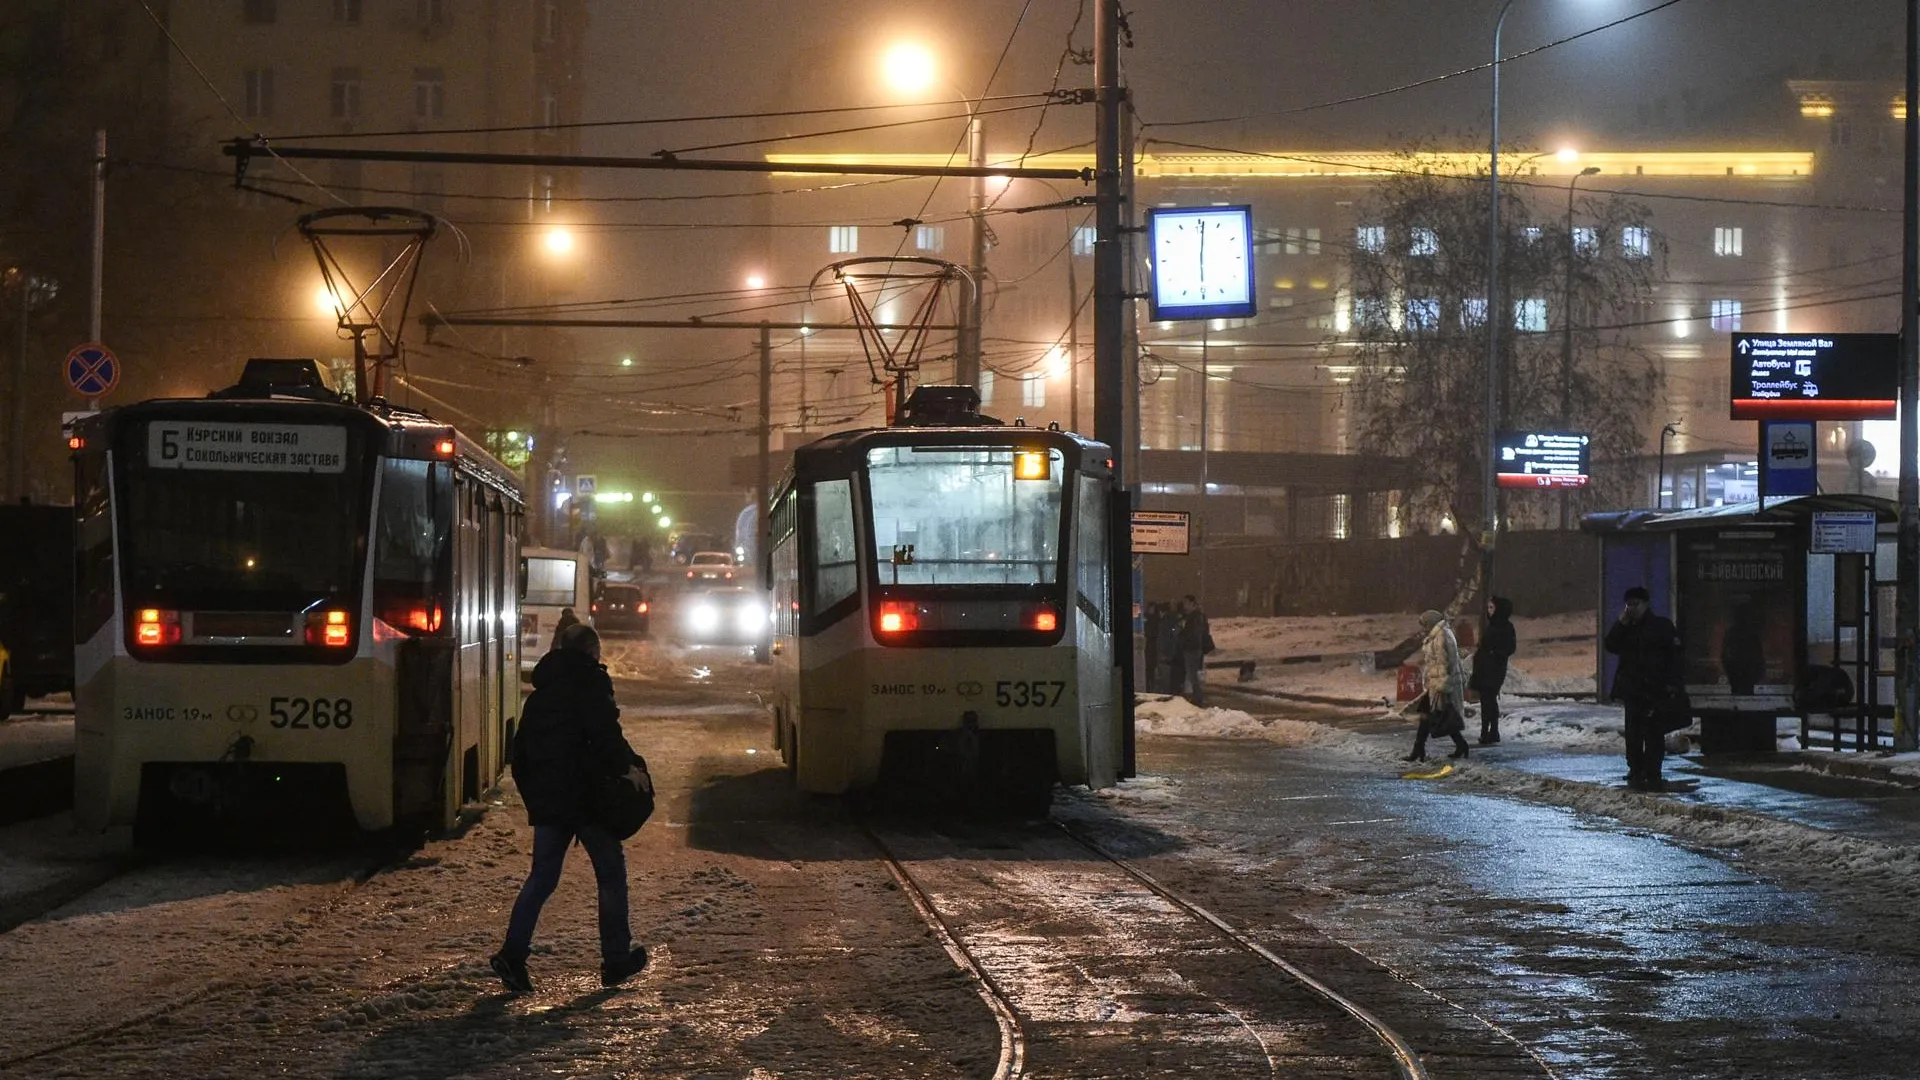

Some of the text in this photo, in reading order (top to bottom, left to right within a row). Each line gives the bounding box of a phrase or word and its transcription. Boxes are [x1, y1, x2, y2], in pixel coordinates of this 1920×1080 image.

[1751, 338, 1833, 348] Улица Земляной Вал
[1752, 359, 1791, 369] Автобусы
[1751, 380, 1798, 390] Троллейбус
[161, 430, 180, 460] Б
[871, 684, 916, 696] ЗАНОС
[996, 680, 1065, 708] 5357
[123, 706, 175, 721] ЗАНОС
[269, 696, 353, 730] 5268
